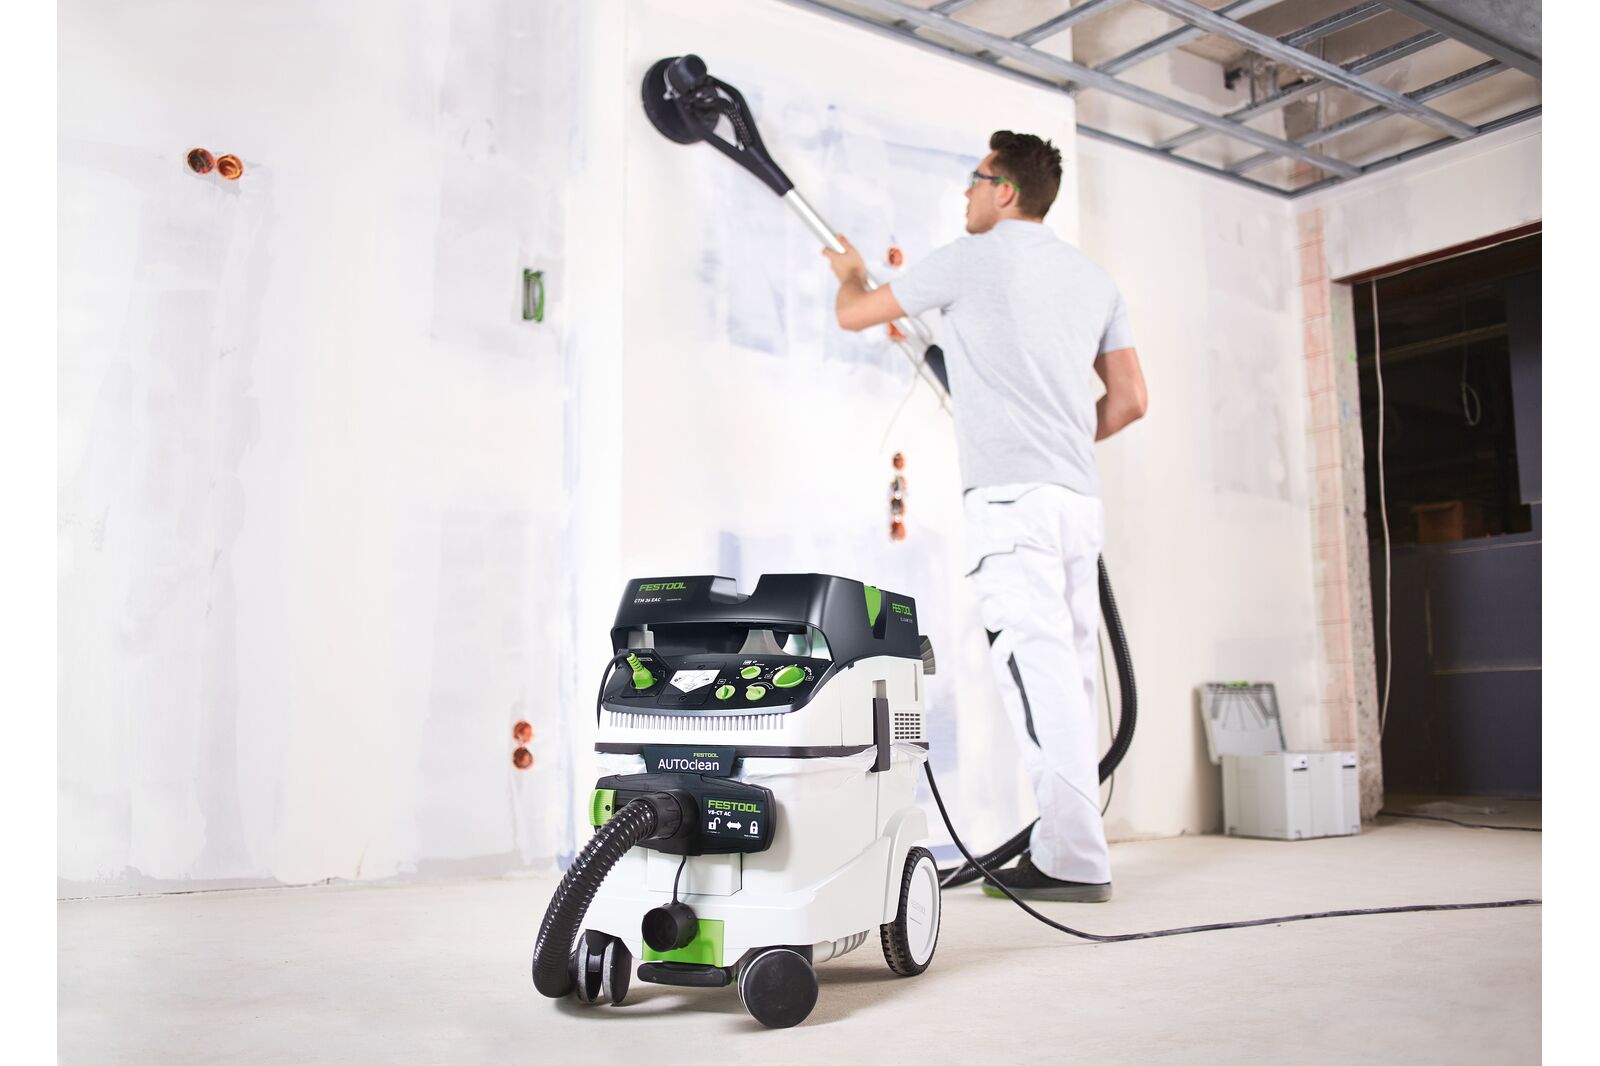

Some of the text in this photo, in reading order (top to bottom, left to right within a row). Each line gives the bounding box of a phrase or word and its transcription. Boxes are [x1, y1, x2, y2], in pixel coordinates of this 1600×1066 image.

[639, 582, 687, 591] FESTOOL
[658, 759, 720, 771] AUTOclean
[708, 799, 761, 814] FESTOOL
